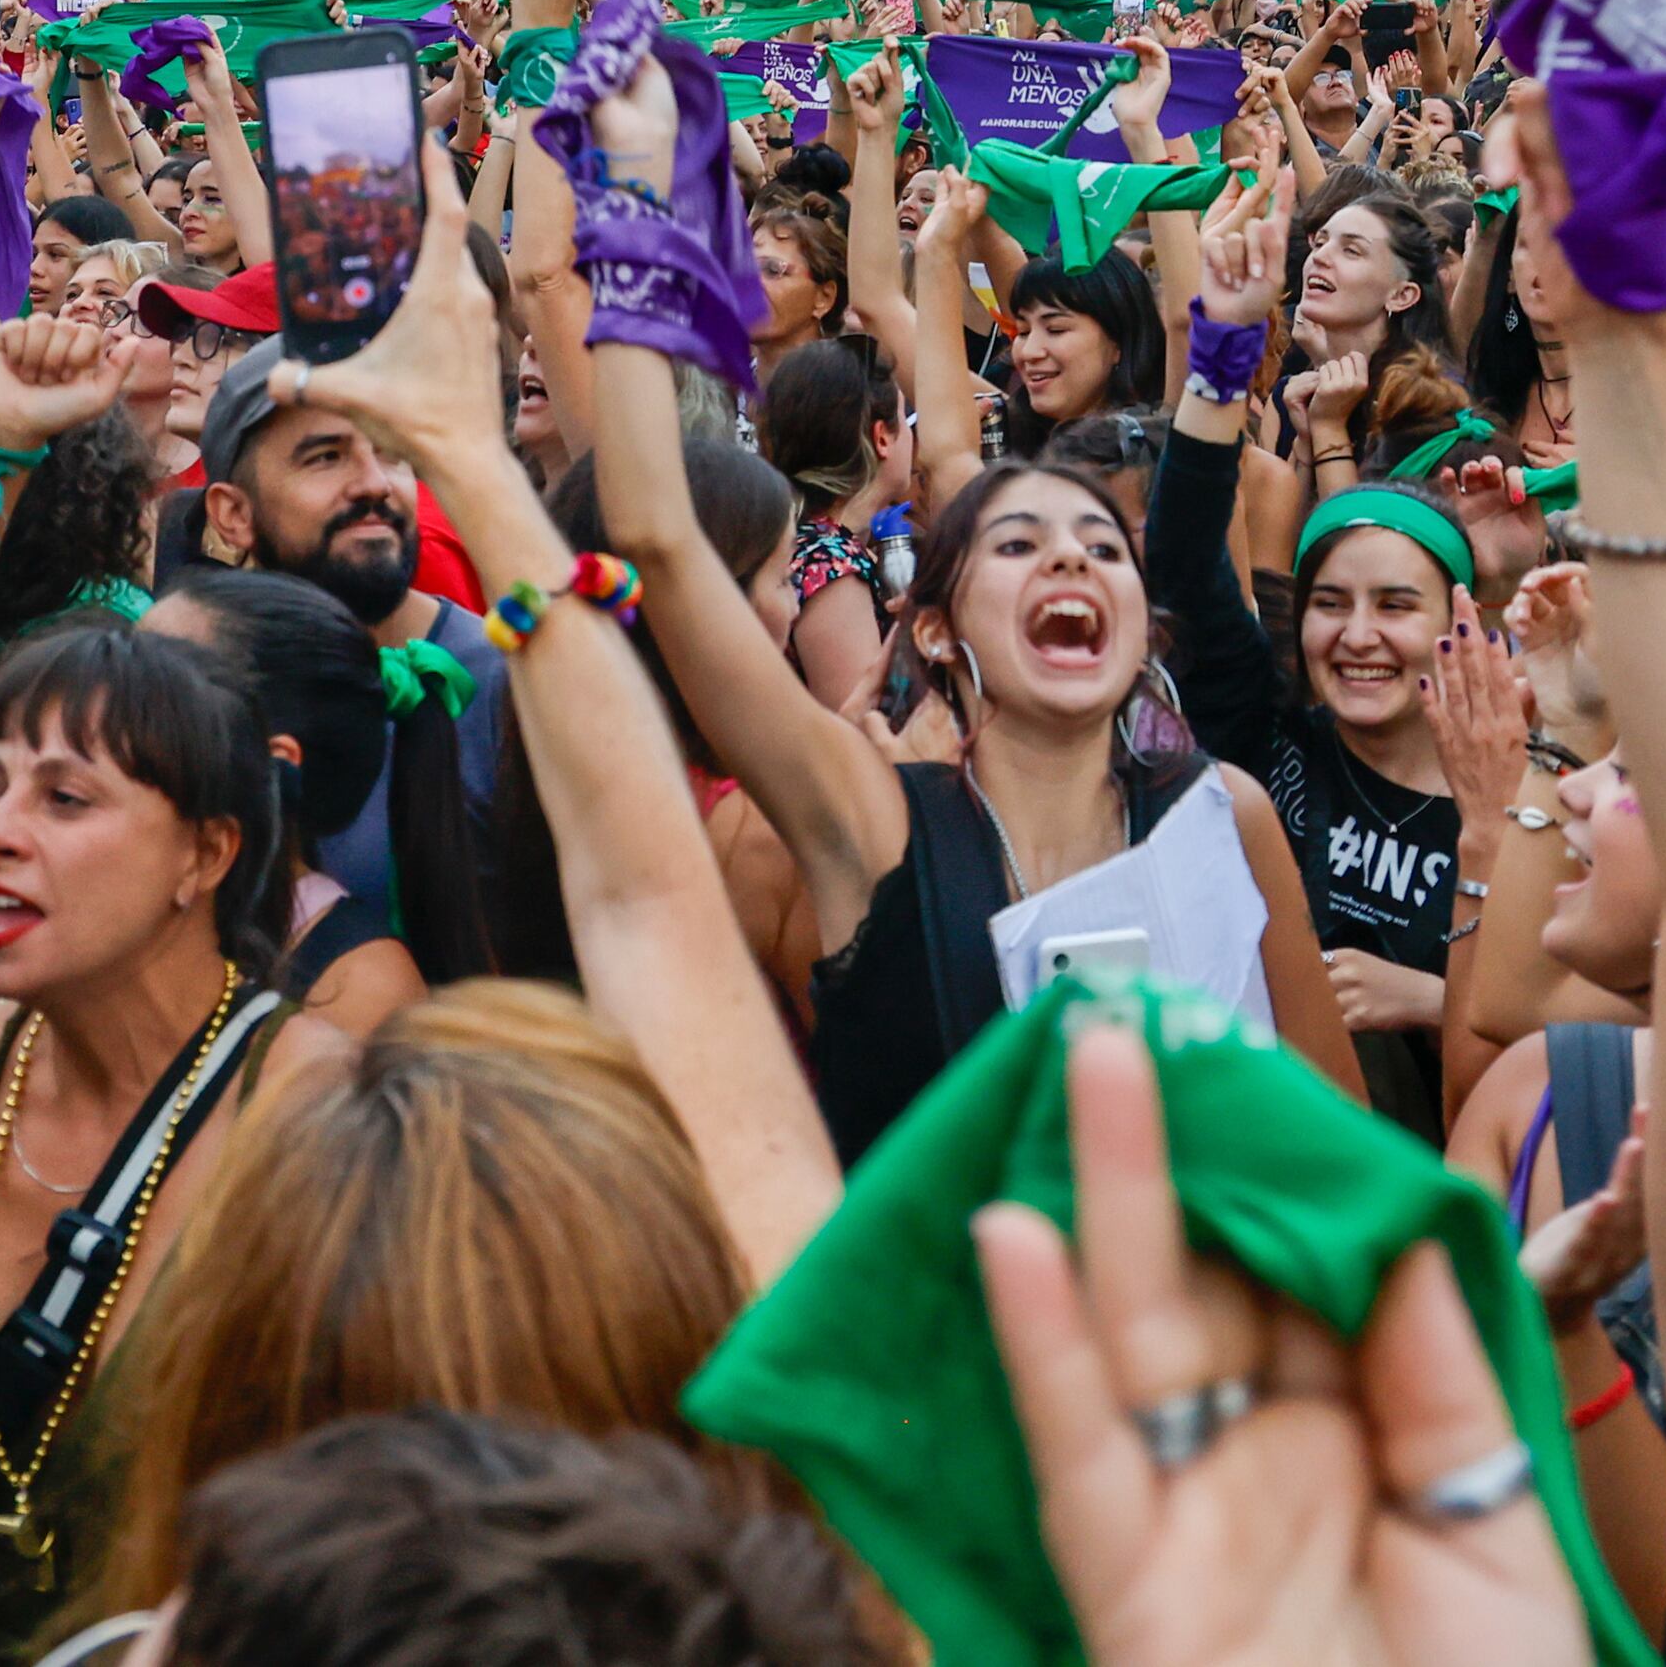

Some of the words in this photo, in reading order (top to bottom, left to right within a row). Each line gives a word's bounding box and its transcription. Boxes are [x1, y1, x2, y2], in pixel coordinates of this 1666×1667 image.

[763, 42, 781, 55] NI
[763, 67, 813, 83] MENOS
[1012, 65, 1057, 84] UNA
[1007, 85, 1086, 107] MENOS
